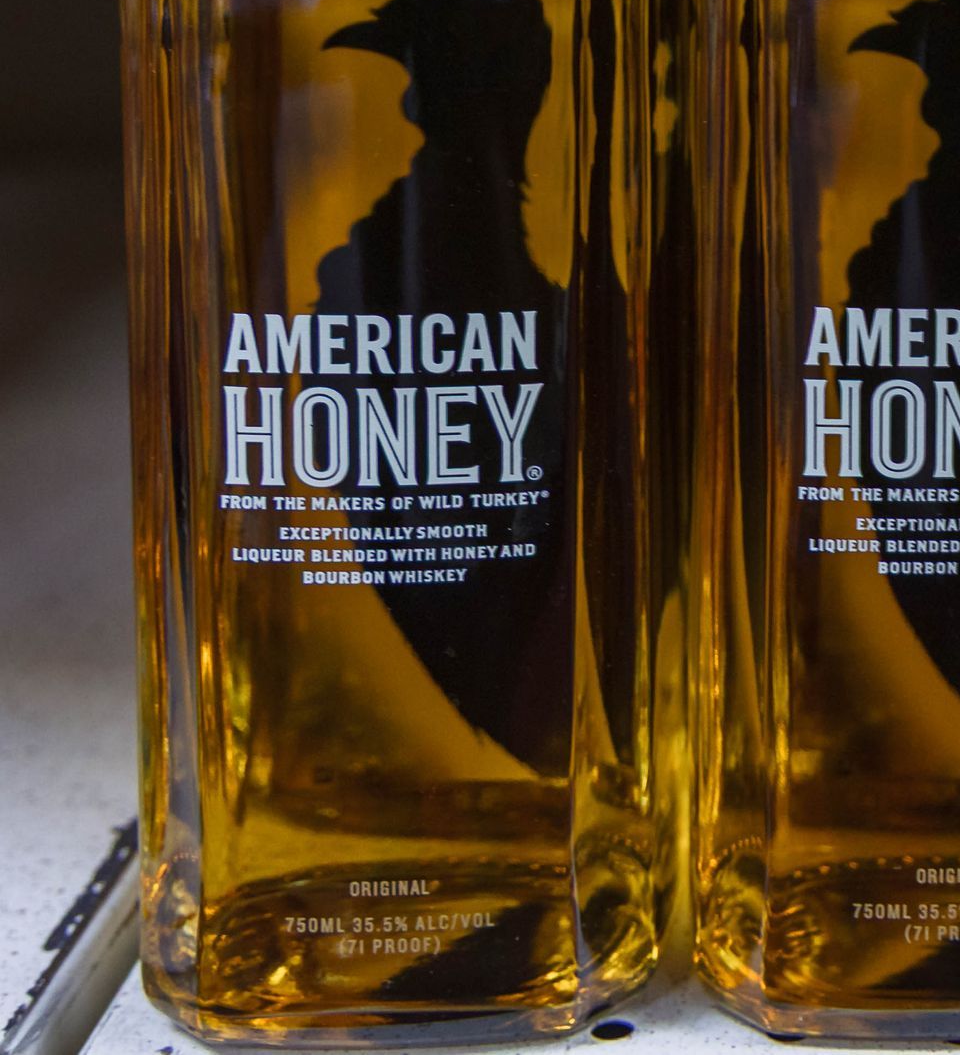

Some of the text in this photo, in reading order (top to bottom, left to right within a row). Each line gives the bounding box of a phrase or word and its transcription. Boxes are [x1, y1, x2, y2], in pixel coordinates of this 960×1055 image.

[222, 310, 539, 375] AMERICAN
[798, 486, 844, 502] FROM
[851, 487, 883, 502] THE
[887, 487, 960, 502] MAKERS
[220, 495, 267, 511] FROM
[273, 496, 306, 511] THE
[311, 495, 385, 511] MAKERS
[391, 496, 413, 510] OF
[418, 495, 463, 509] WILD
[279, 524, 488, 541] EXCEPTIONALLY SMOOTH
[232, 543, 536, 563] LIQUEUR BLENDED WITH HONEY AND
[808, 538, 880, 553] LIQUEUR
[886, 540, 960, 554] BLENDED
[303, 568, 468, 585] BOURBON WHISKEY
[877, 561, 958, 576] BOURBON
[349, 880, 430, 896] ORIGINAL
[852, 902, 911, 919] 750ML
[284, 912, 495, 933] 750ML 35.5% ALC/VOL
[904, 924, 930, 943] (71
[337, 936, 441, 957] (71 PROOF)
